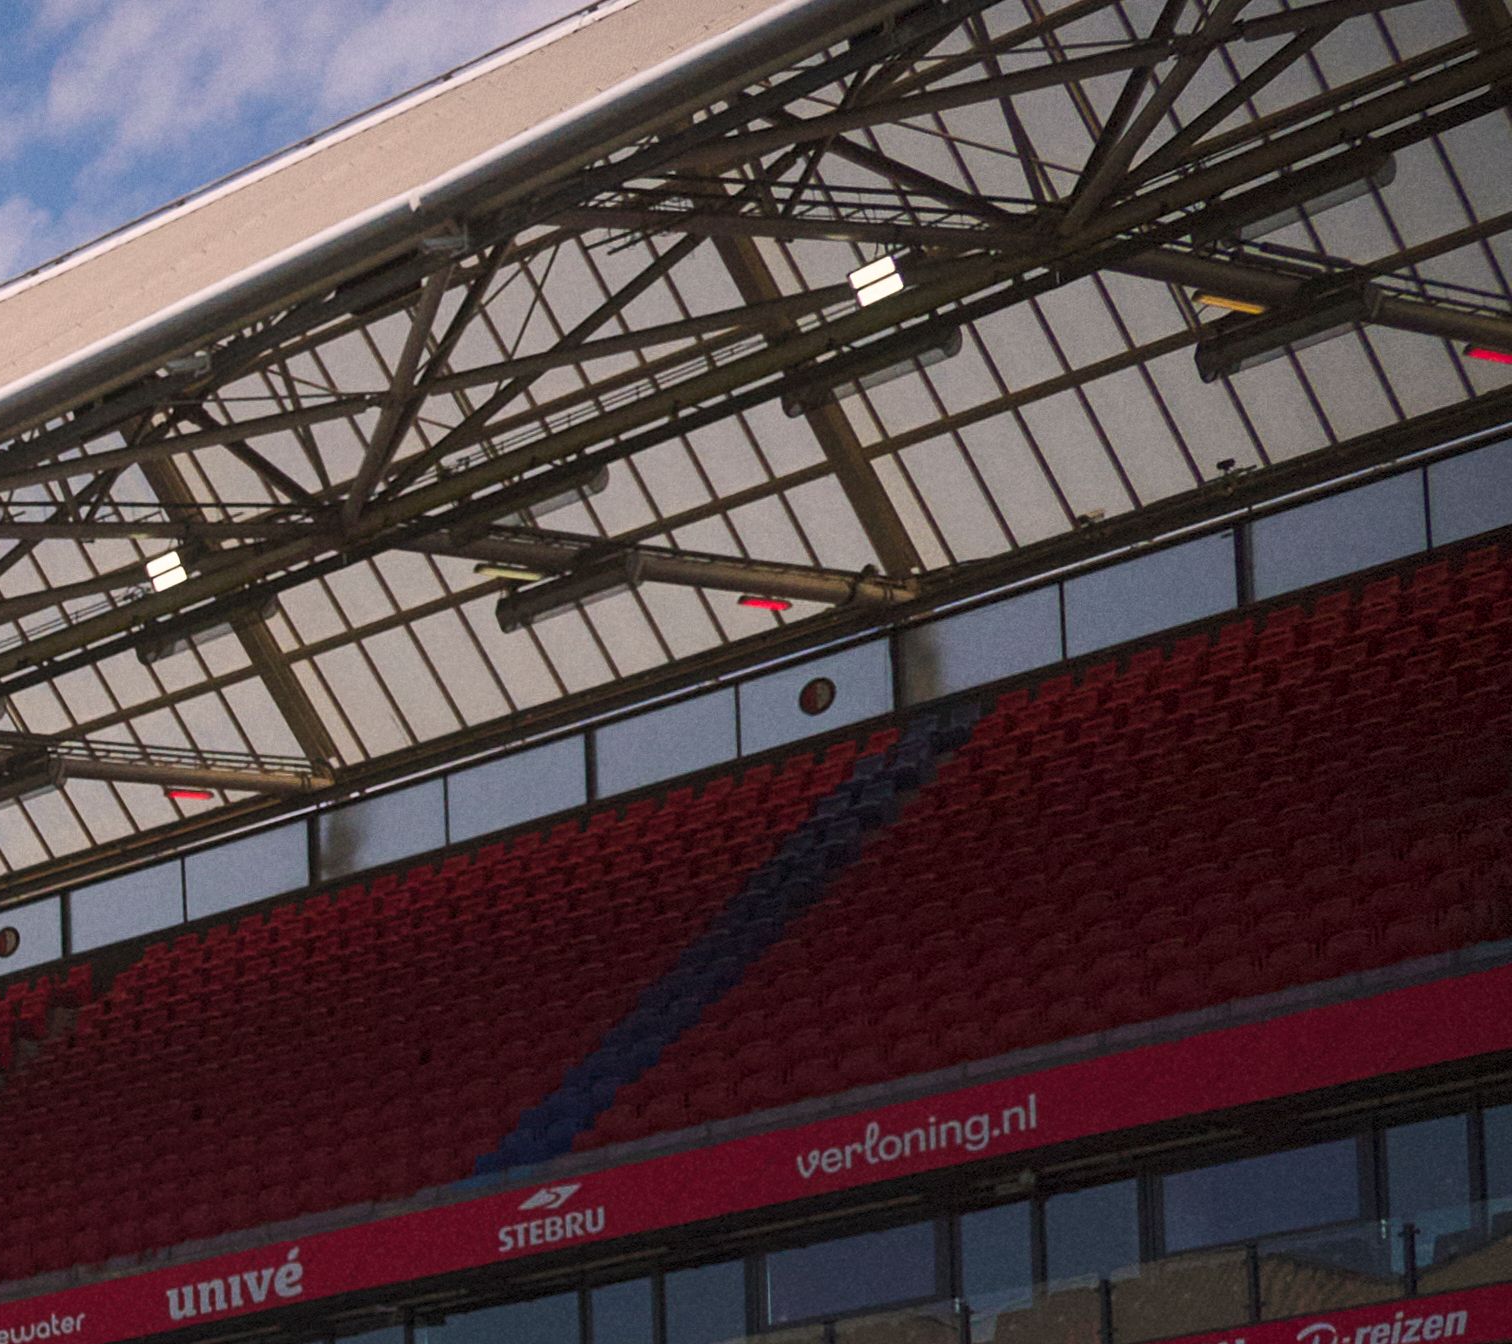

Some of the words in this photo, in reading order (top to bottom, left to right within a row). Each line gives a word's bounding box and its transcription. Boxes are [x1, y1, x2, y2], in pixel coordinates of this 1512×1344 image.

[796, 1093, 1038, 1179] verloning.nl
[498, 1205, 605, 1252] STEBRU
[166, 1246, 304, 1321] univé
